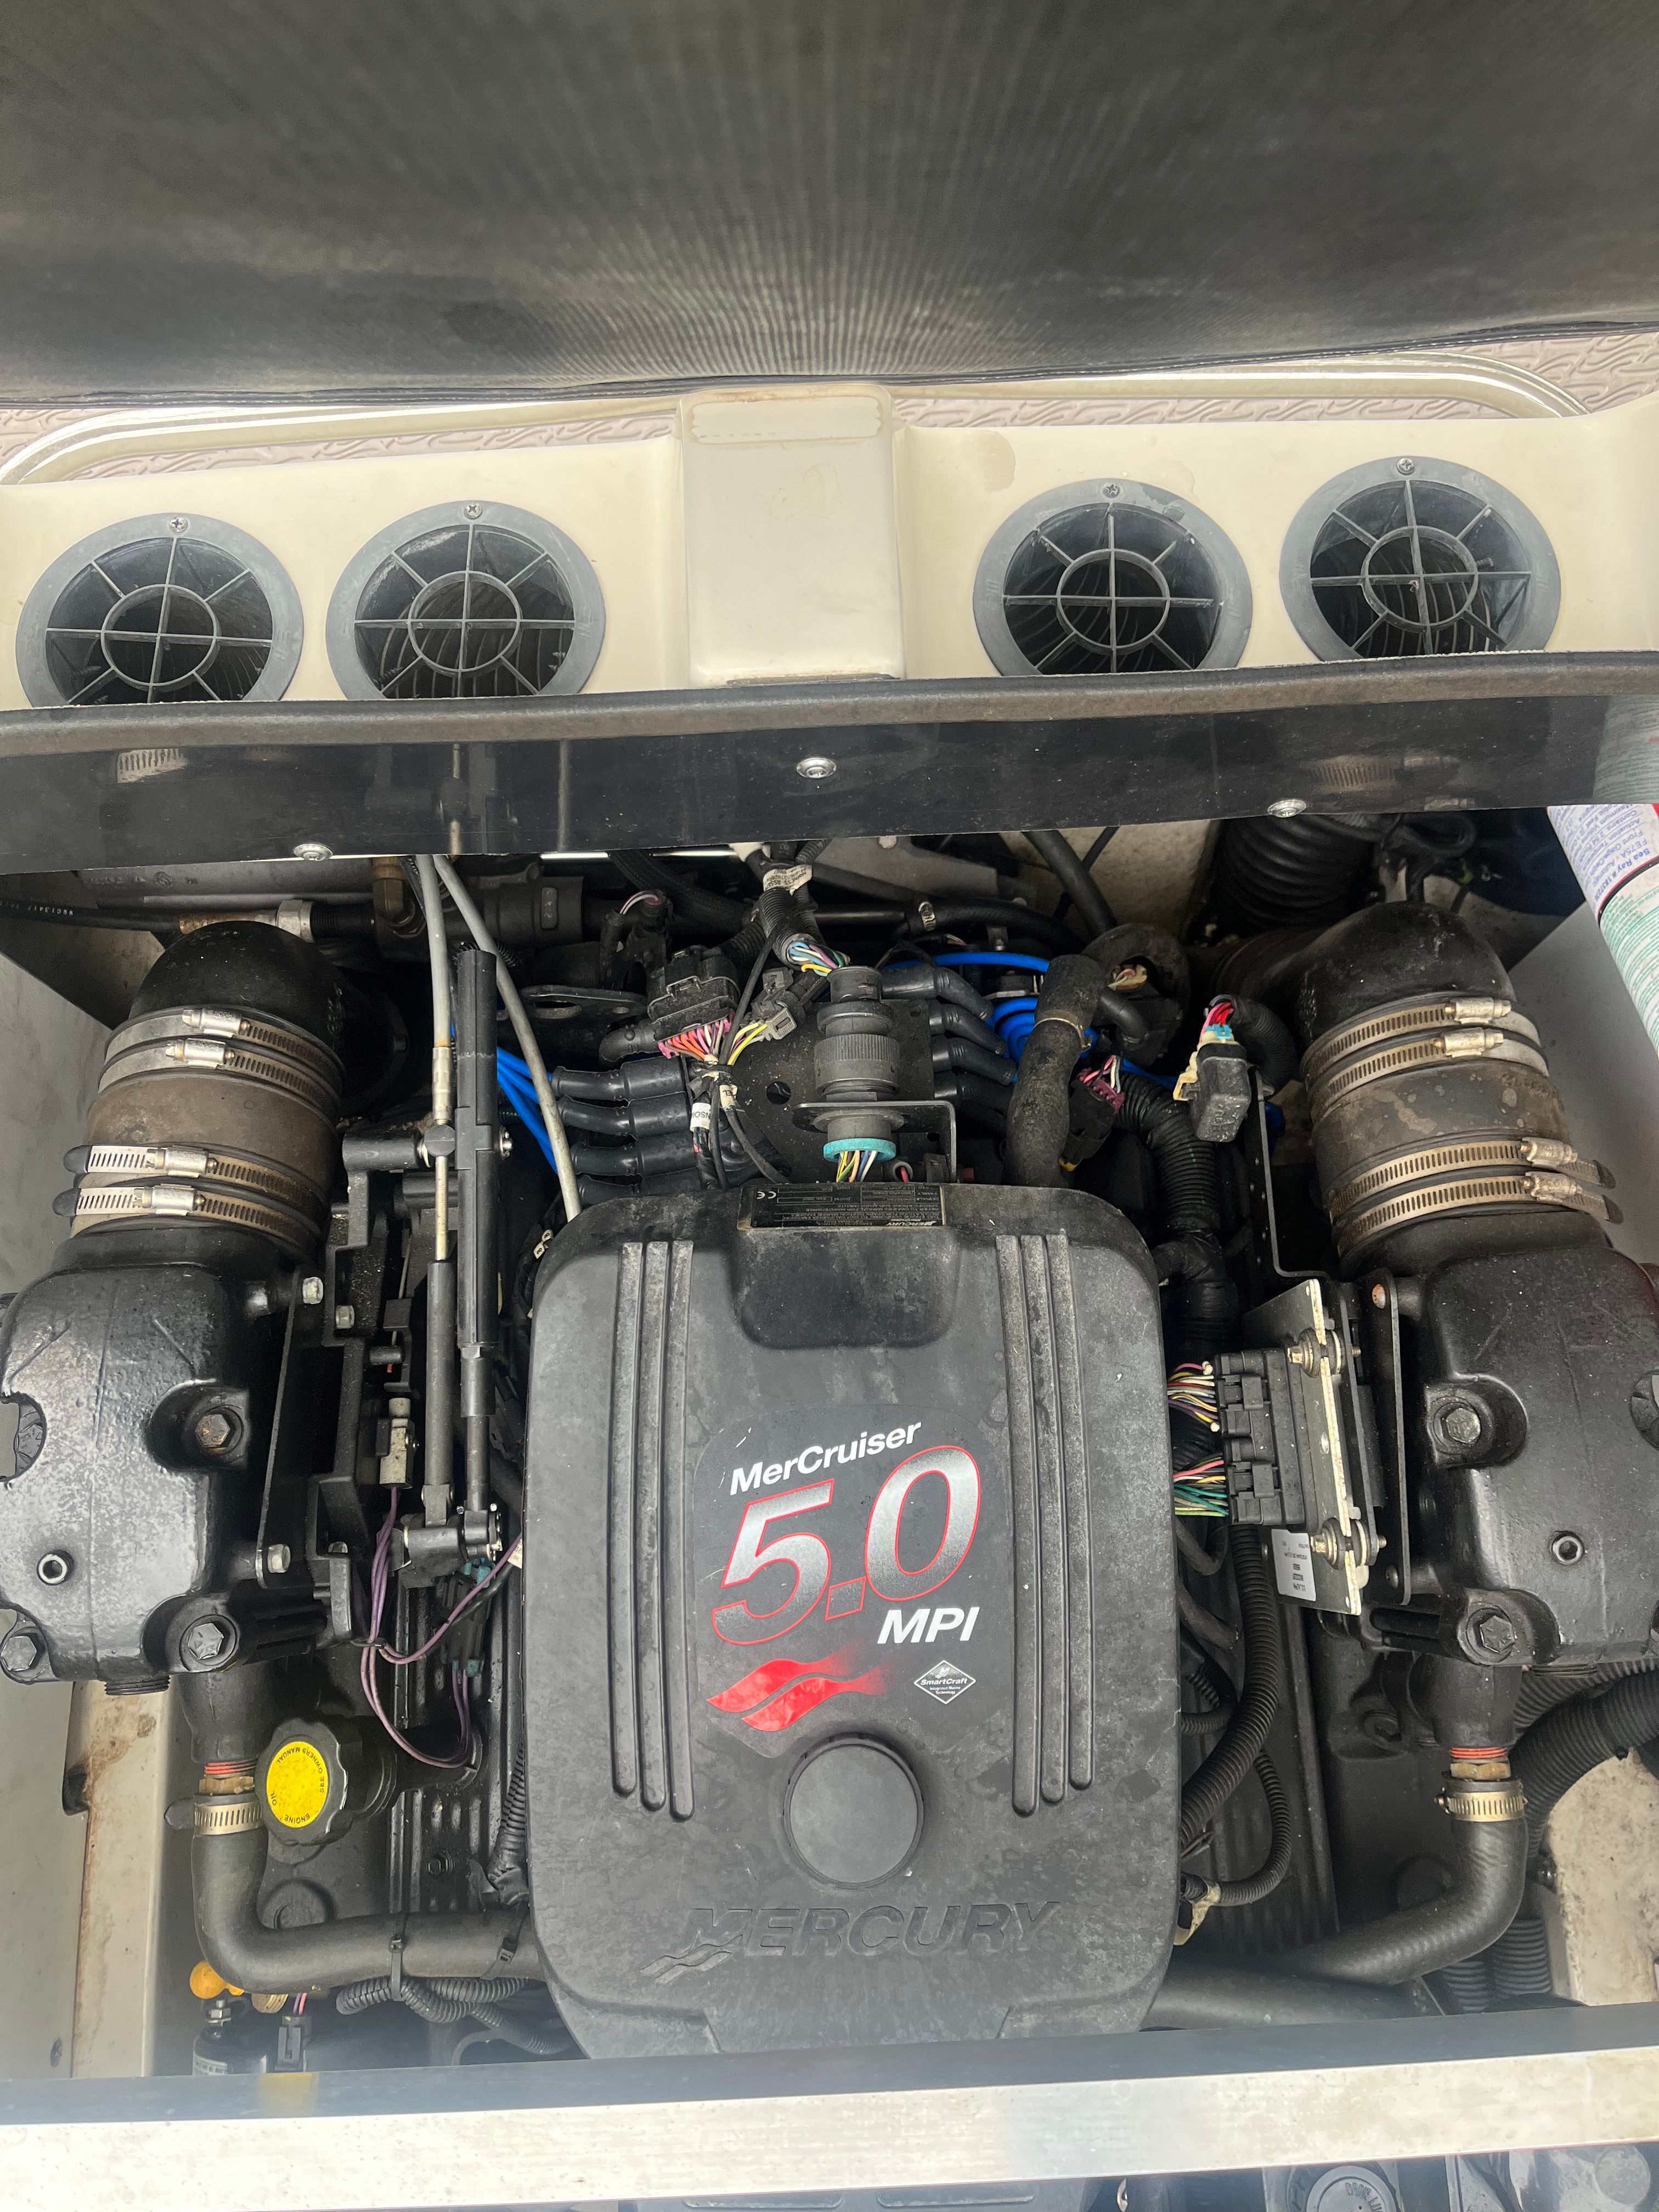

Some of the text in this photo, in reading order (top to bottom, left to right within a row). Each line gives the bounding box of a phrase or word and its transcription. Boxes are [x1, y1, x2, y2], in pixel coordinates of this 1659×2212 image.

[1609, 818, 1640, 840] Actuation
[1622, 830, 1643, 845] Front
[1620, 838, 1647, 858] FE75A
[1633, 849, 1650, 860] Sea
[1618, 859, 1632, 872] Ray
[730, 1422, 921, 1496] MerCruiser
[712, 1444, 981, 1646] 5.0
[877, 1607, 980, 1644] MPI
[276, 1747, 300, 1763] MANUAL
[302, 1748, 323, 1774] OWNERS
[284, 1813, 310, 1824] ENGINE
[661, 1901, 1060, 1961] MERCURY
